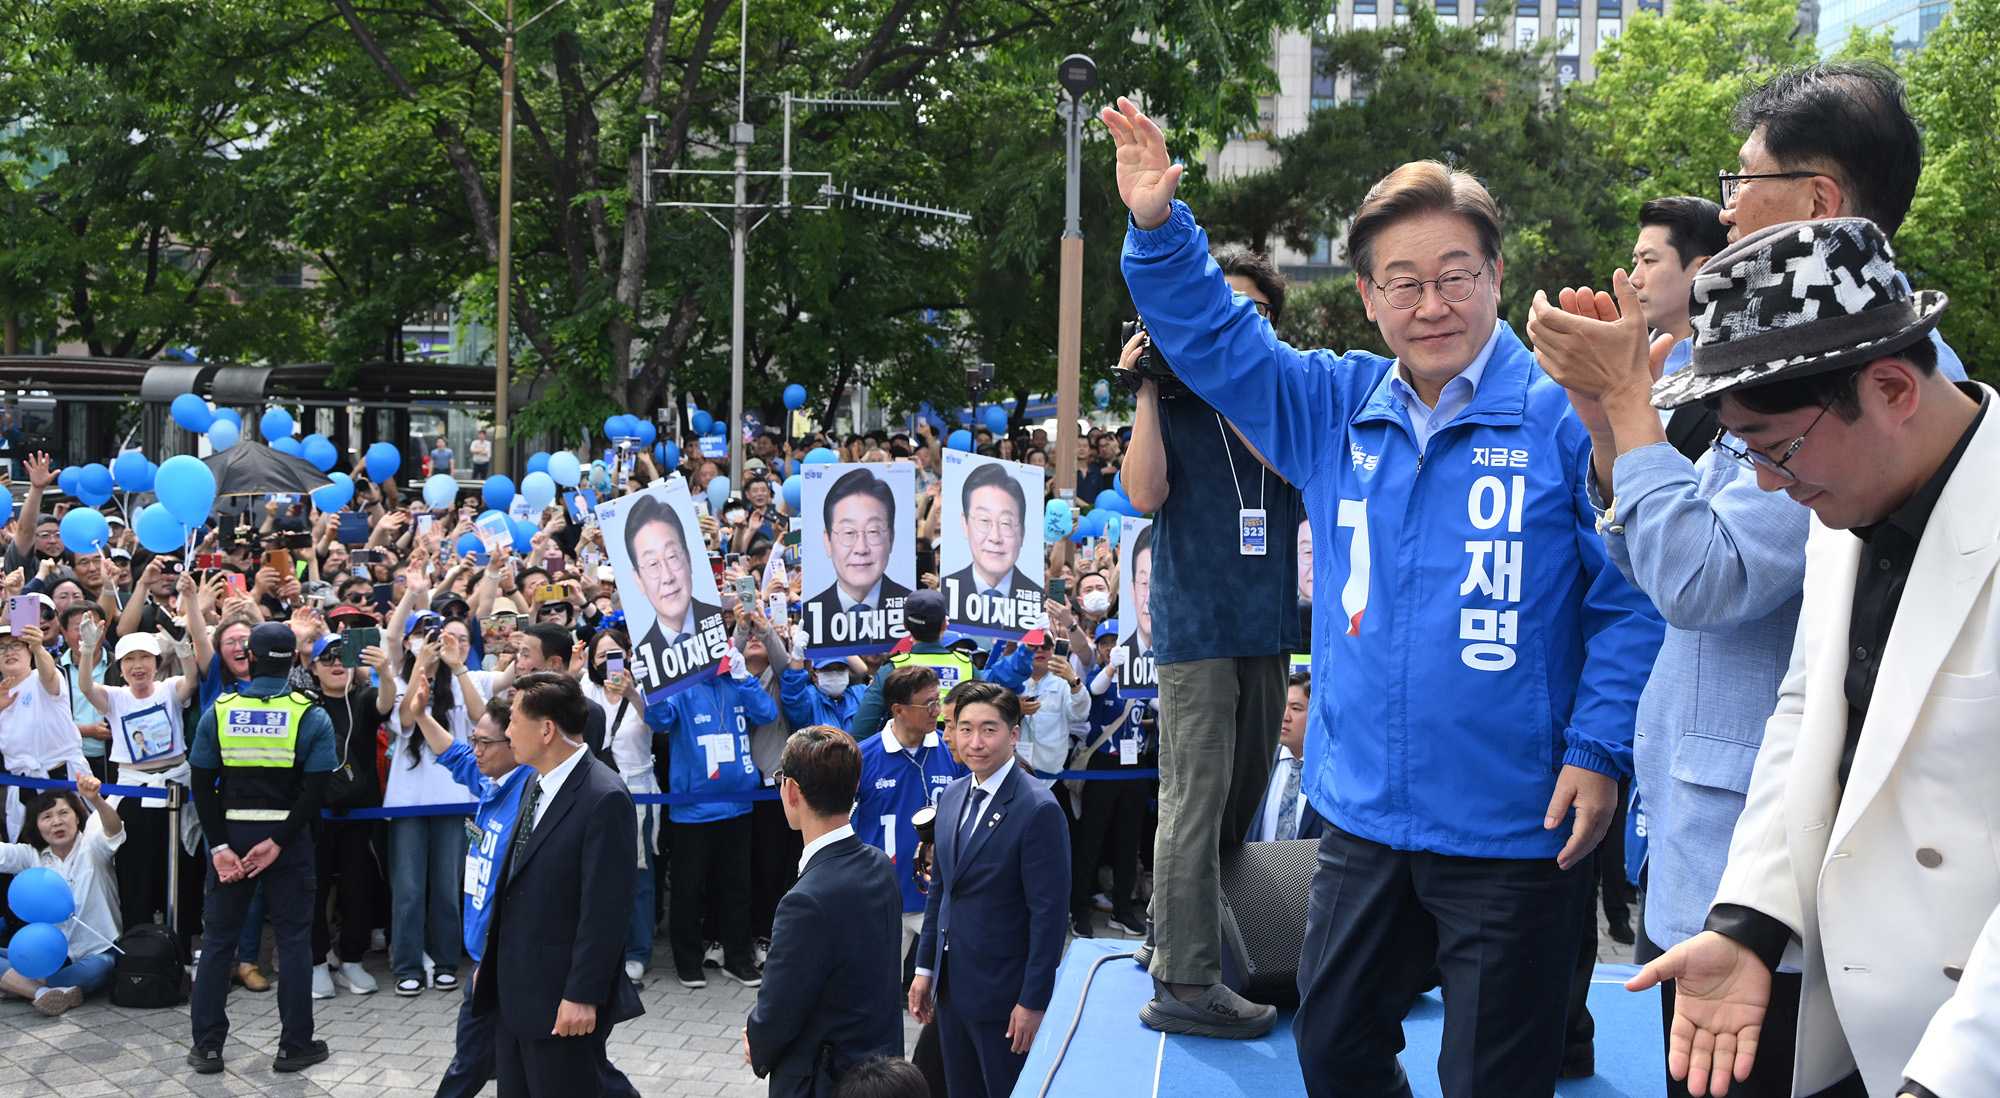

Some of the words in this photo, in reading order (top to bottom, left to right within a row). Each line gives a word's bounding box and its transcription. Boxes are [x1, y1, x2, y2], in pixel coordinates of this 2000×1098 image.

[1351, 450, 1380, 471] 주당
[1472, 447, 1529, 468] 지금은
[1243, 527, 1264, 537] 323
[1337, 498, 1371, 637] 1
[1459, 475, 1526, 672] 이재명
[945, 578, 960, 620] 1
[965, 593, 1042, 630] 이재명
[1016, 589, 1041, 602] 지금은
[700, 613, 723, 631] 지금은
[808, 602, 823, 645] 1
[1104, 621, 1109, 630] 1
[639, 642, 661, 688] 1
[662, 624, 730, 679] 이재명
[1120, 645, 1130, 685] 1
[941, 668, 955, 679] 찰
[234, 710, 284, 726] 경찰
[232, 726, 281, 735] POLICE
[697, 734, 719, 779] 1
[931, 775, 954, 784] 지금은
[880, 814, 896, 865] 1
[1207, 1000, 1239, 1017] HOKA
